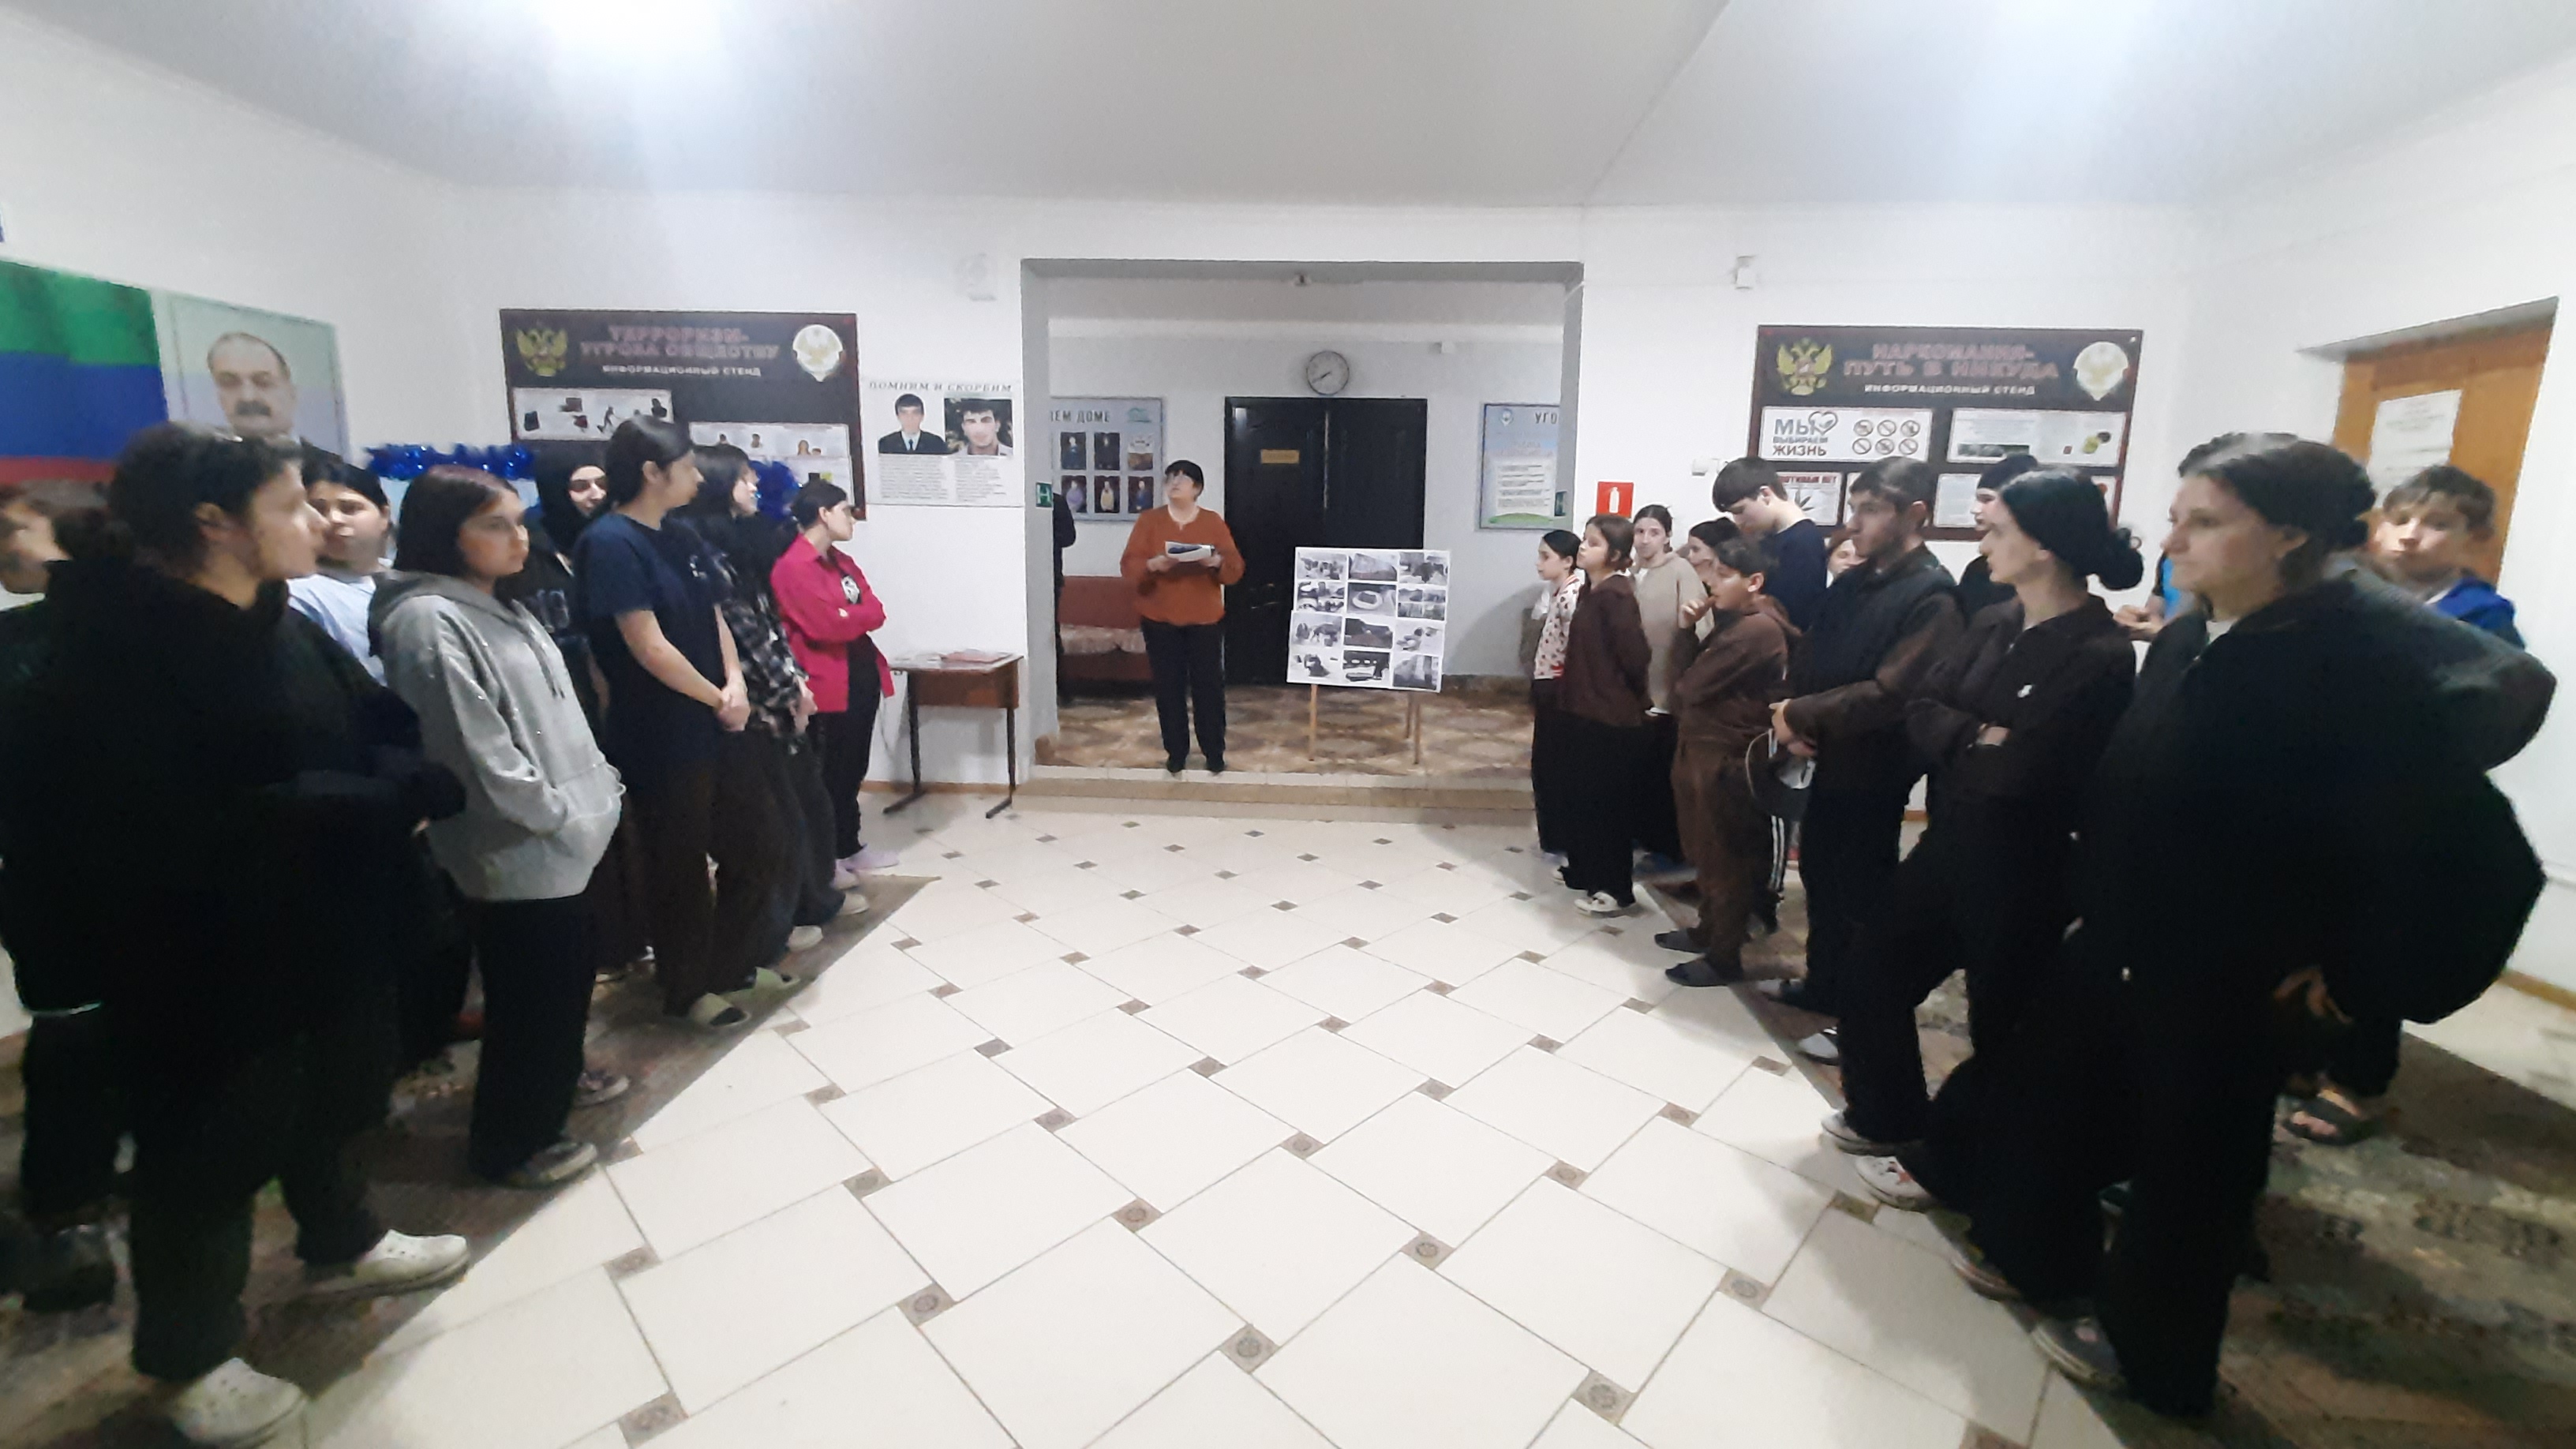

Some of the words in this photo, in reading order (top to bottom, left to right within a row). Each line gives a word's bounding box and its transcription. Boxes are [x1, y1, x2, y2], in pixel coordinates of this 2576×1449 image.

[1872, 343, 2035, 361] НАРКОМАНИЯ-
[602, 365, 719, 376] ИНФОРМАЦИОННЫЙ
[723, 367, 762, 377] СТЕНД
[1844, 360, 1914, 376] ПУТЬ
[1923, 361, 1942, 377] В
[1951, 361, 2060, 380] НИКУДА
[869, 381, 929, 391] ПОМНИМ
[934, 381, 942, 391] И
[947, 382, 1012, 393] СКОРБИМ
[1864, 384, 1990, 395] ИНФОРМАЦИОННЫЙ
[1994, 384, 2035, 396] СТЕНД
[1076, 410, 1110, 424] ДОМЕ
[1774, 418, 1815, 436] МЫ
[1773, 444, 1827, 457] ЖИЗНЬ
